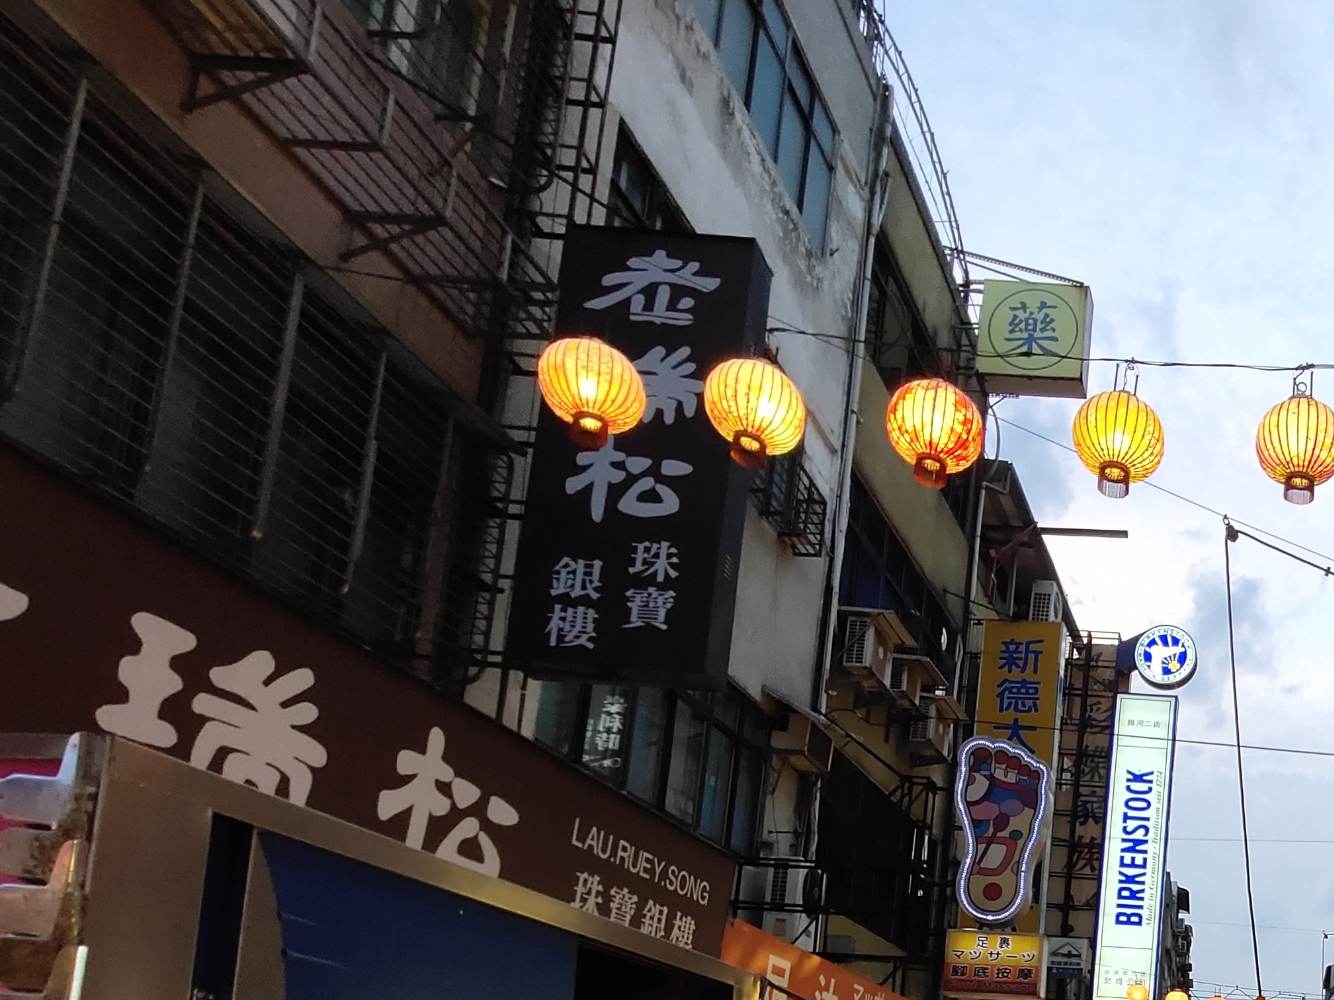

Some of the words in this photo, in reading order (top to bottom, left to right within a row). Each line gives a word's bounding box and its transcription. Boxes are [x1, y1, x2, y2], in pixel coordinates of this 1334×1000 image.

[1004, 300, 1059, 358] 藥
[544, 556, 604, 650] 銀樓
[622, 541, 681, 631] 珠寶
[1115, 769, 1155, 927] BIRKENSTOCK
